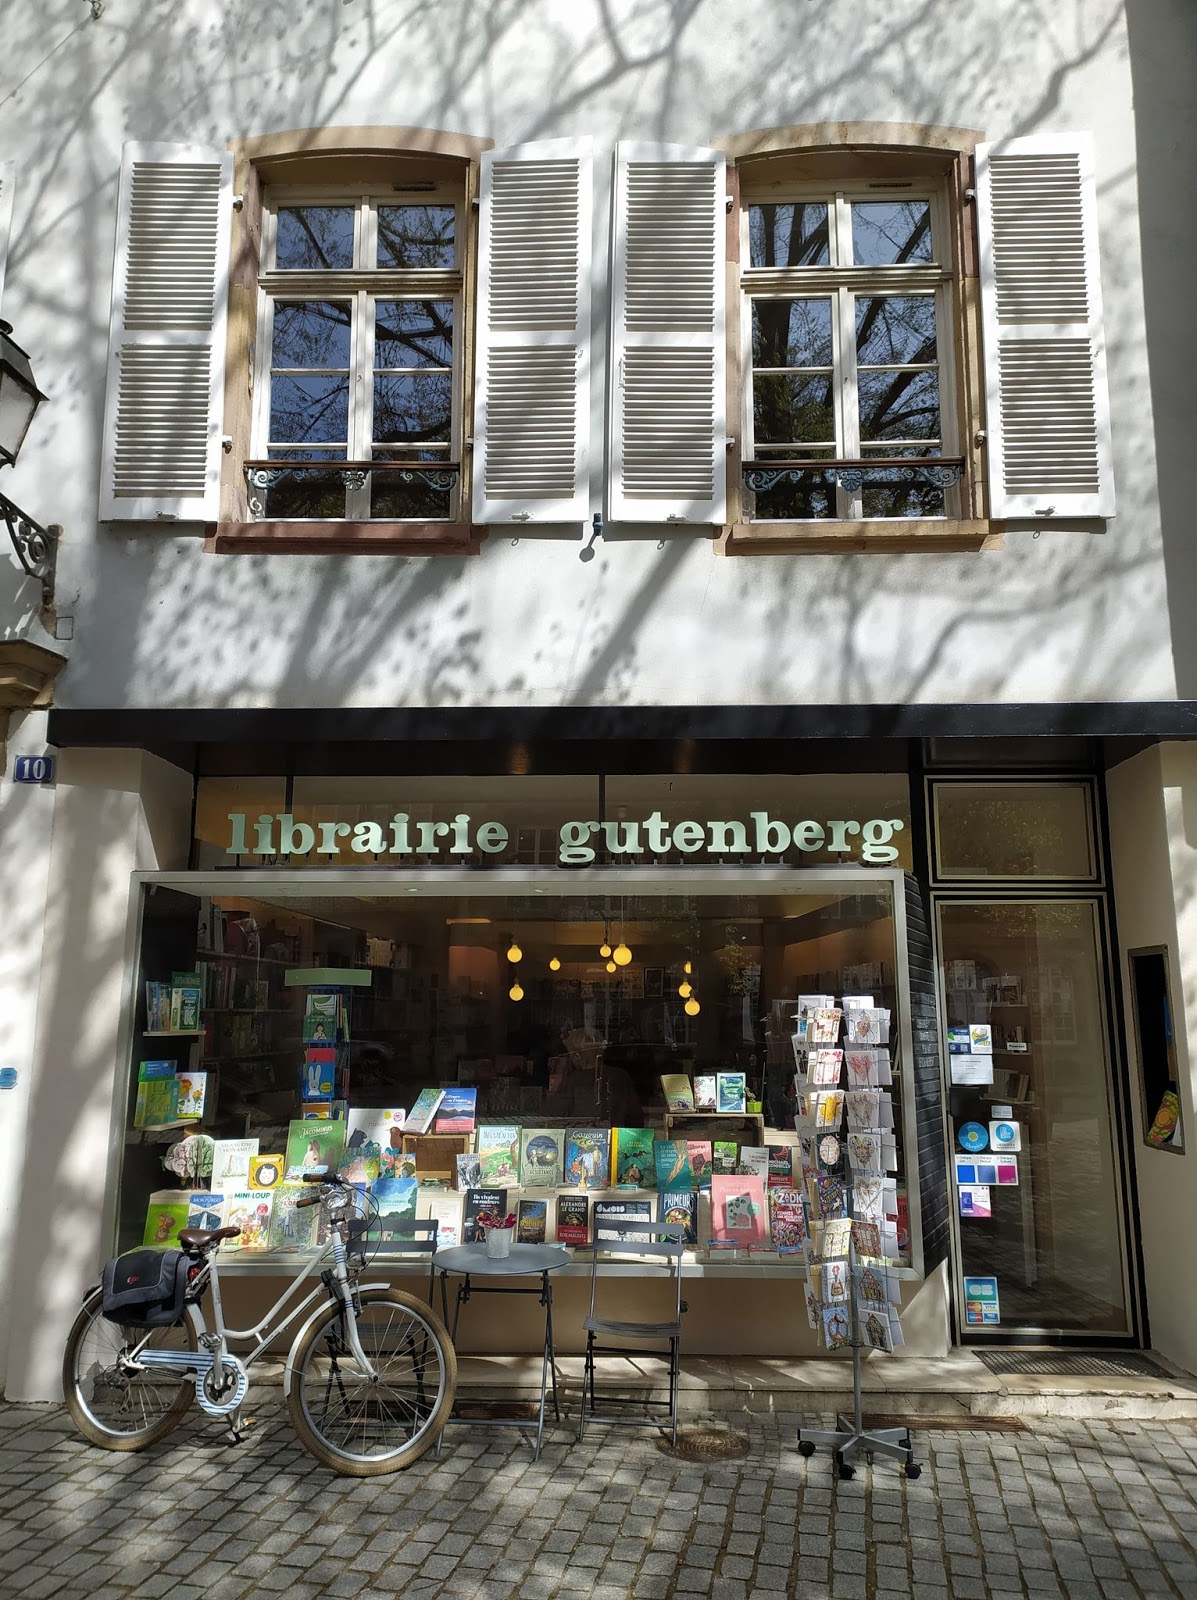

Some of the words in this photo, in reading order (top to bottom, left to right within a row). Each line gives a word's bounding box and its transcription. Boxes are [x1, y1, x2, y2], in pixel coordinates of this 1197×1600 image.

[22, 759, 46, 780] 10
[226, 813, 509, 855] librairie
[558, 812, 904, 863] gutenberg
